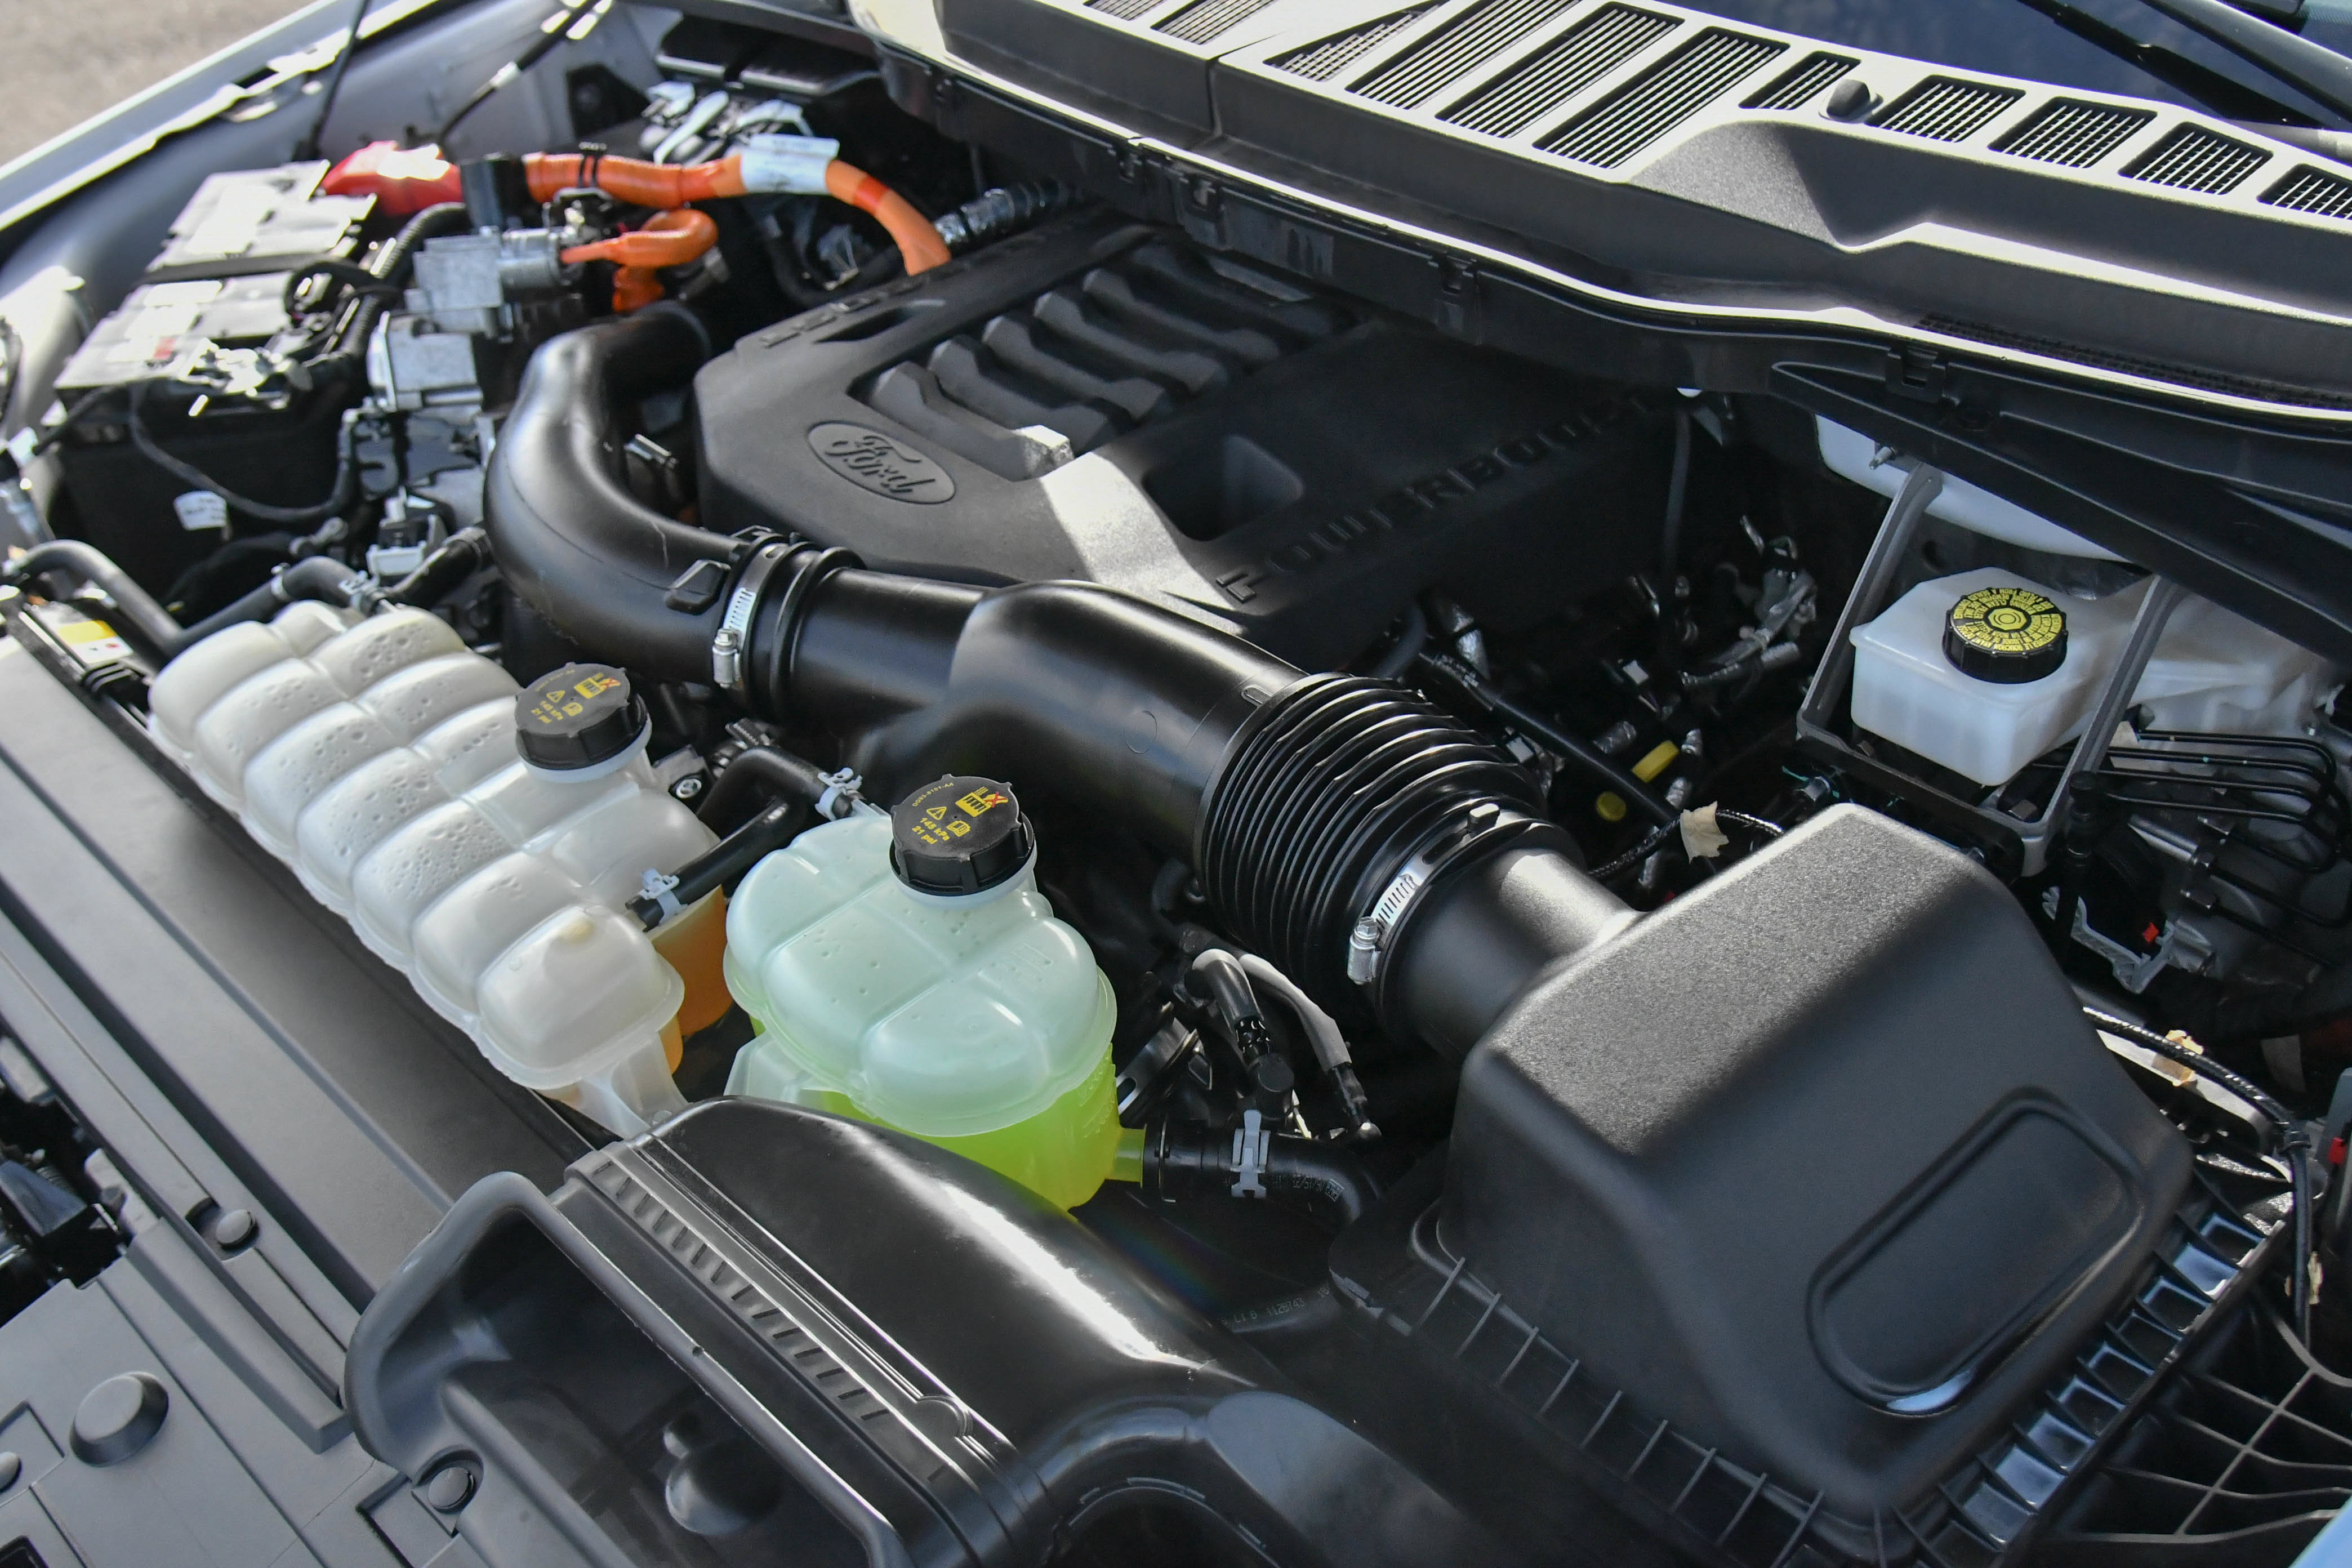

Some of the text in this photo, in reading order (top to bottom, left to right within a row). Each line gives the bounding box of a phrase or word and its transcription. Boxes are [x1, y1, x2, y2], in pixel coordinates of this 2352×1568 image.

[825, 435, 936, 493] Ford
[912, 826, 925, 835] 21
[920, 817, 950, 841] 145 kPa
